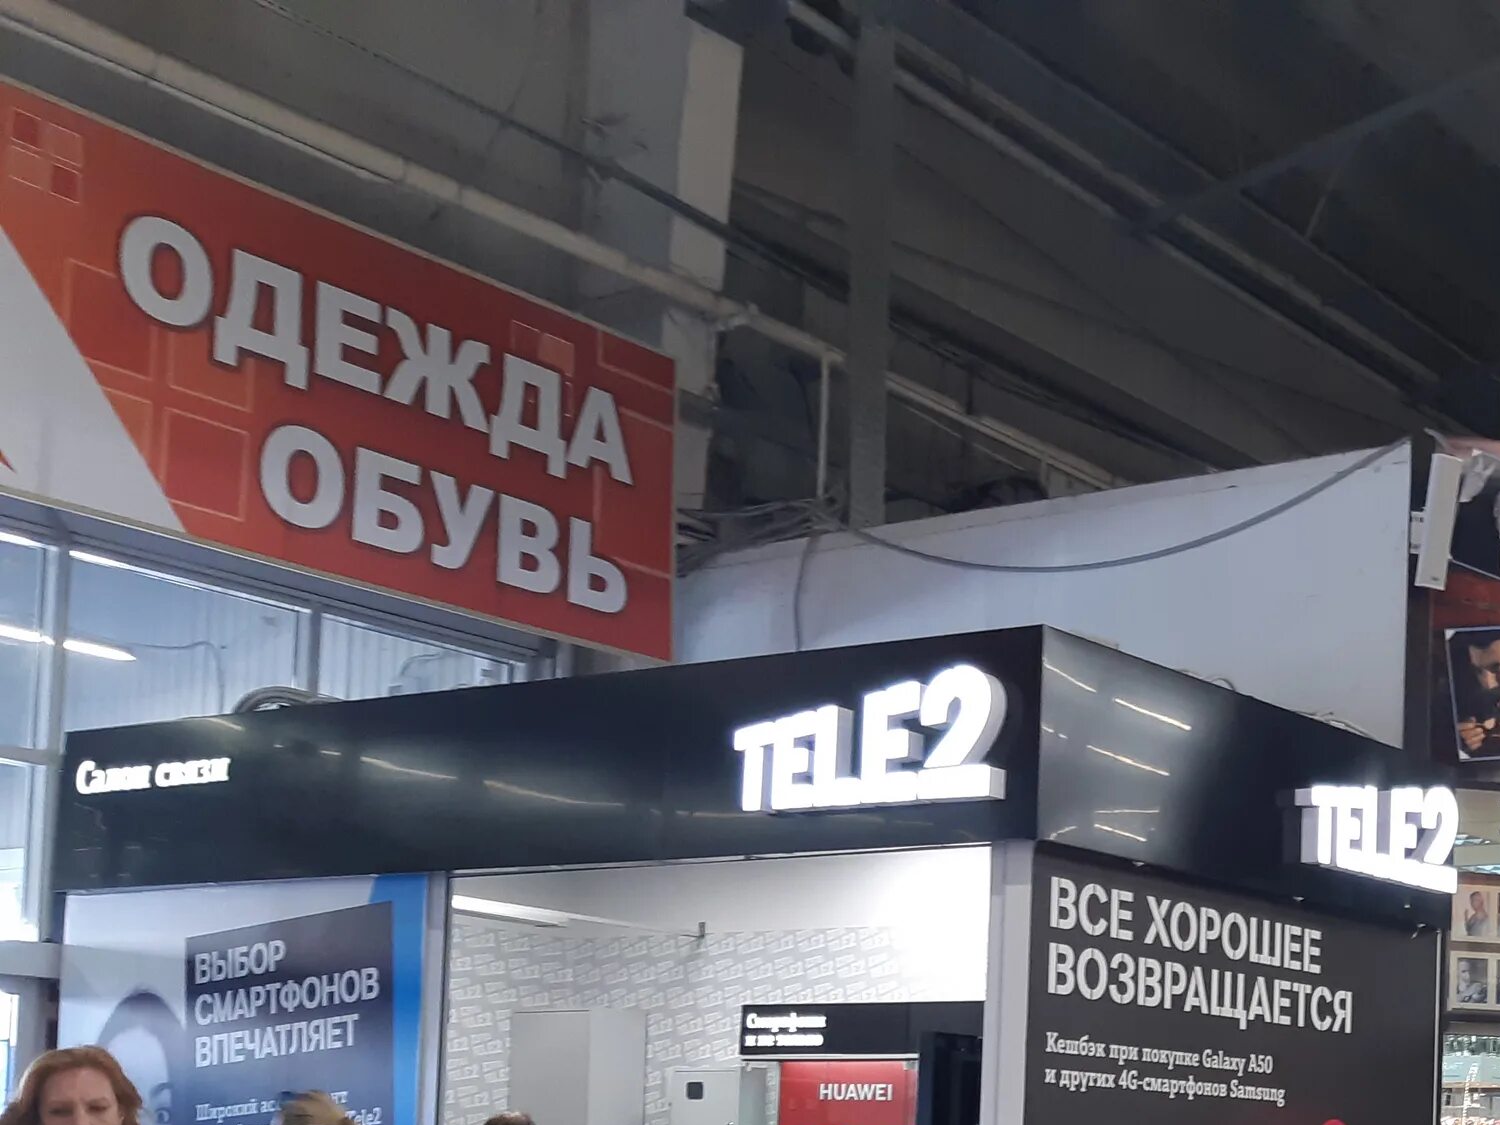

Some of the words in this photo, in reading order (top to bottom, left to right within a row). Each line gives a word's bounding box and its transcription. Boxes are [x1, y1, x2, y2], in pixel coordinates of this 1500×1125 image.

[119, 214, 634, 486] ОДЕЖДА
[259, 424, 629, 614] ОБУВЬ
[732, 664, 1007, 814] TELE2
[1296, 784, 1459, 895] TELE2
[1050, 876, 1135, 941] ВСЕ
[1144, 895, 1322, 974] ХОРОШЕЕ
[194, 940, 287, 986] ВЫБОР
[1047, 942, 1353, 1034] ВОЗВРАЩАЕТСЯ
[194, 967, 381, 1028] СМАРТФОНОВ
[194, 1013, 360, 1070] ВПЕЧАТЛЯЕТ
[1045, 1032, 1106, 1058] Кешбэк
[1109, 1041, 1139, 1065] при
[1142, 1045, 1200, 1071] покупке
[1202, 1049, 1247, 1077] Galaxy
[1247, 1054, 1274, 1074] A50
[195, 1099, 259, 1124] Широкий
[819, 1083, 894, 1101] HUAWEI
[1044, 1069, 1056, 1084] и
[1059, 1069, 1116, 1093] других
[1118, 1069, 1227, 1101] 4G-смартфонов
[1229, 1079, 1287, 1108] Samsung
